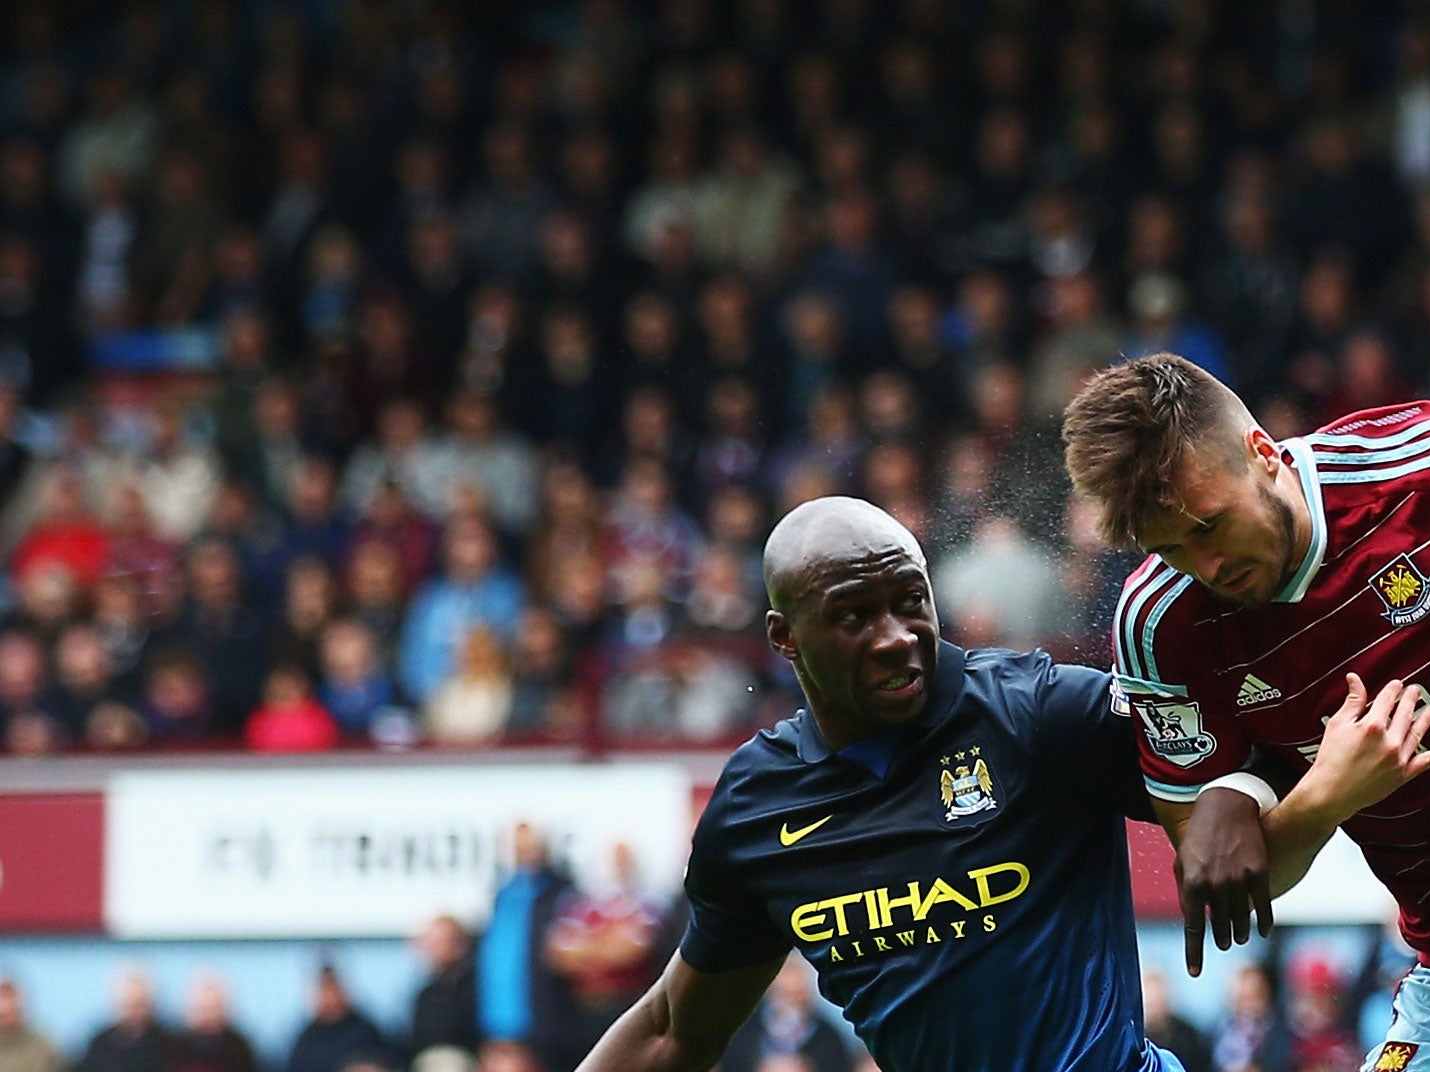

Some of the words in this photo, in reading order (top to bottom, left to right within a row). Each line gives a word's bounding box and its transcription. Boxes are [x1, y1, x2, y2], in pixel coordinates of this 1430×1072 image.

[1236, 688, 1282, 707] adidas
[791, 861, 1031, 942] ETIHAD
[830, 913, 998, 962] AIRWAYS
